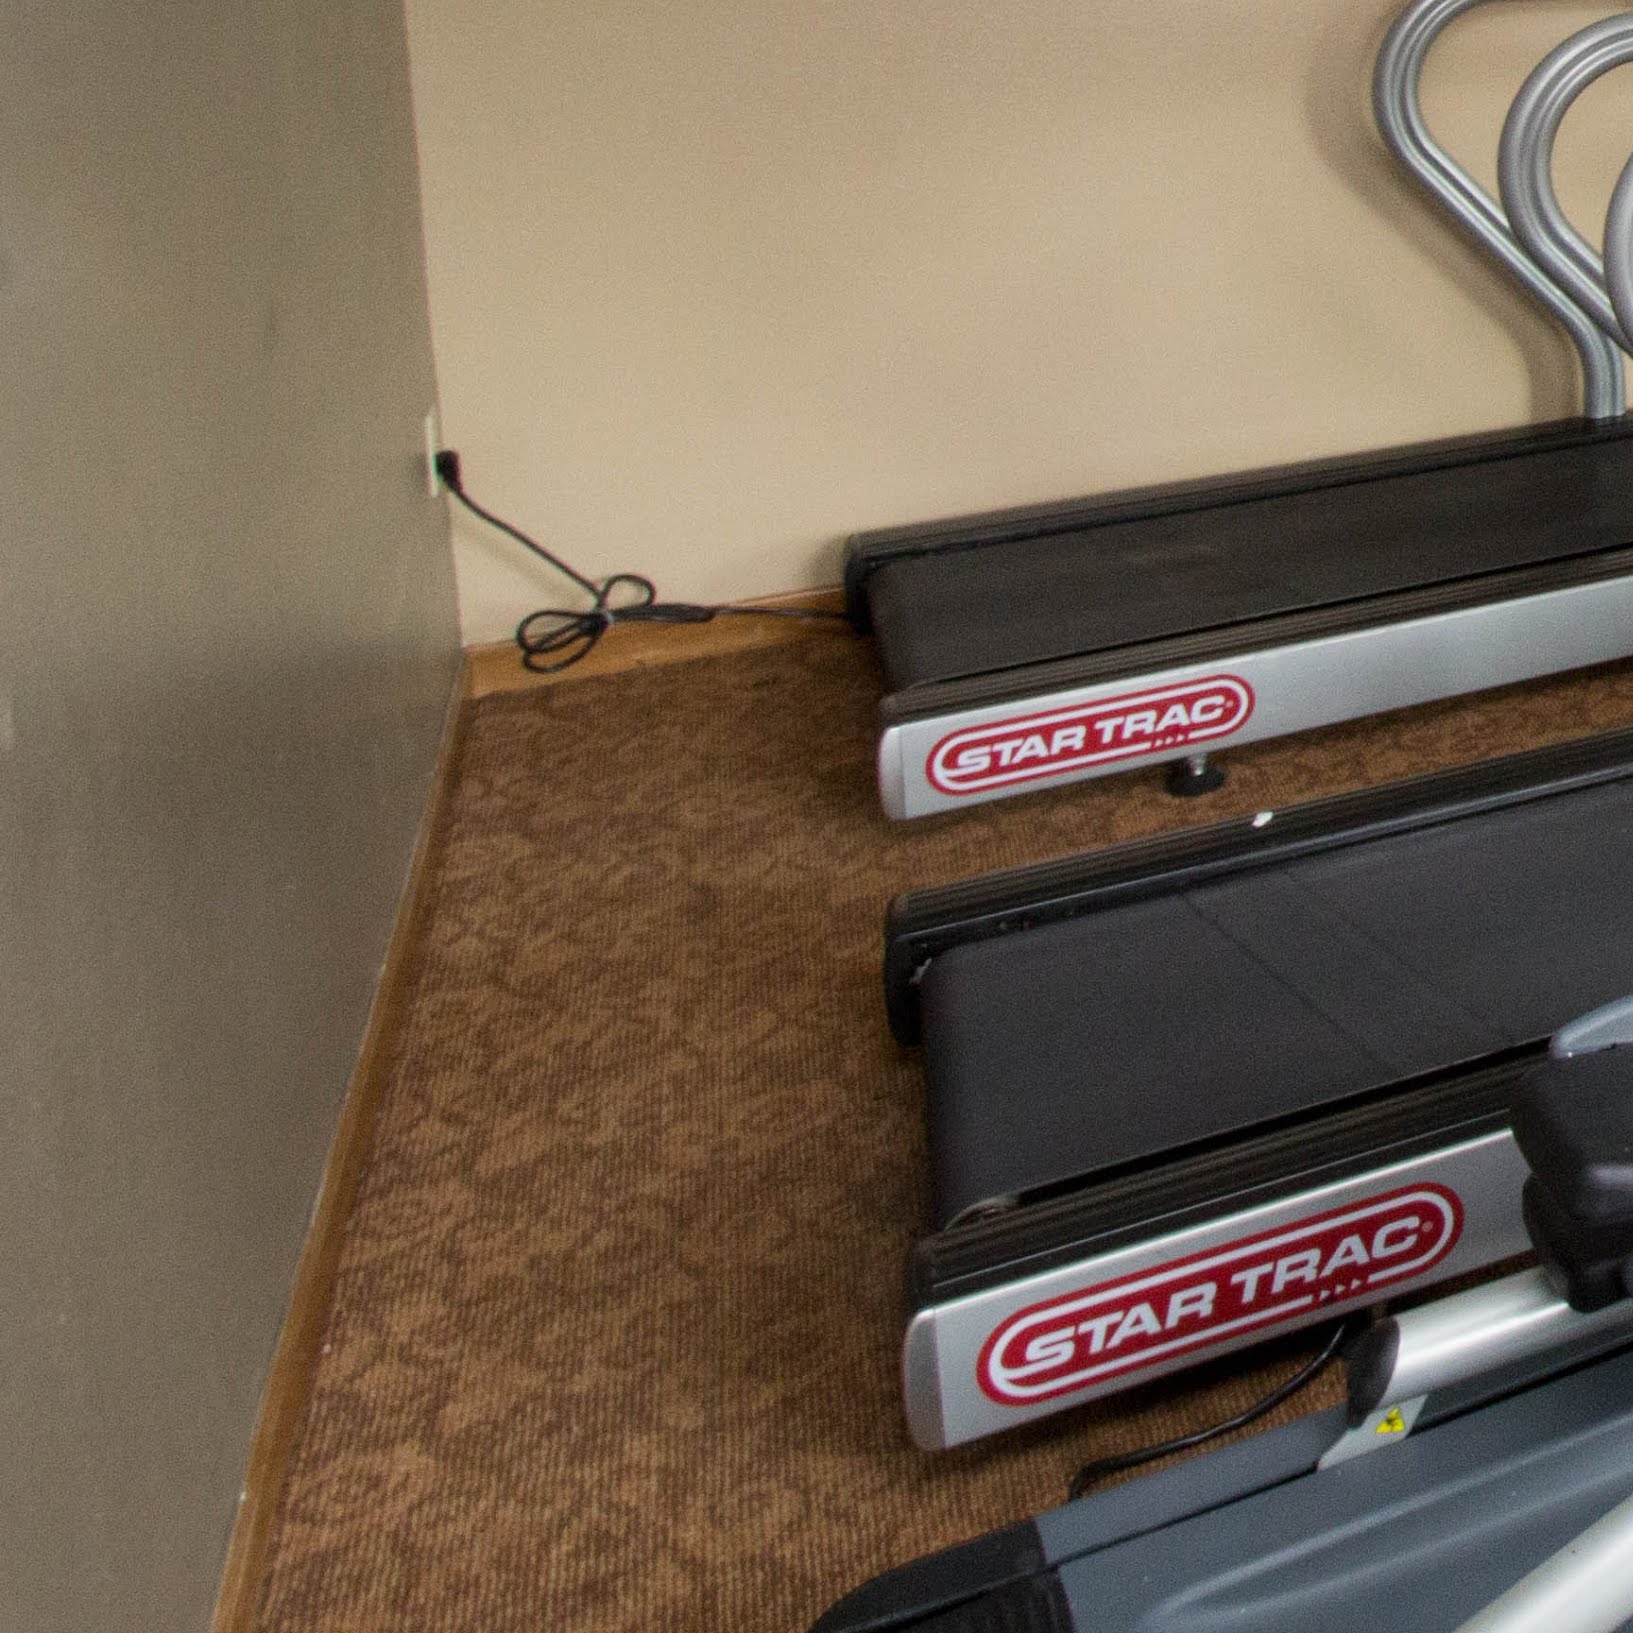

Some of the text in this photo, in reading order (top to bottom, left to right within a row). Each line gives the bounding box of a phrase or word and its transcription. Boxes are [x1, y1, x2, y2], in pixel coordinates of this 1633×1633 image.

[954, 694, 1228, 776] STAR TRAC
[1024, 1217, 1423, 1368] STAR TRAC
